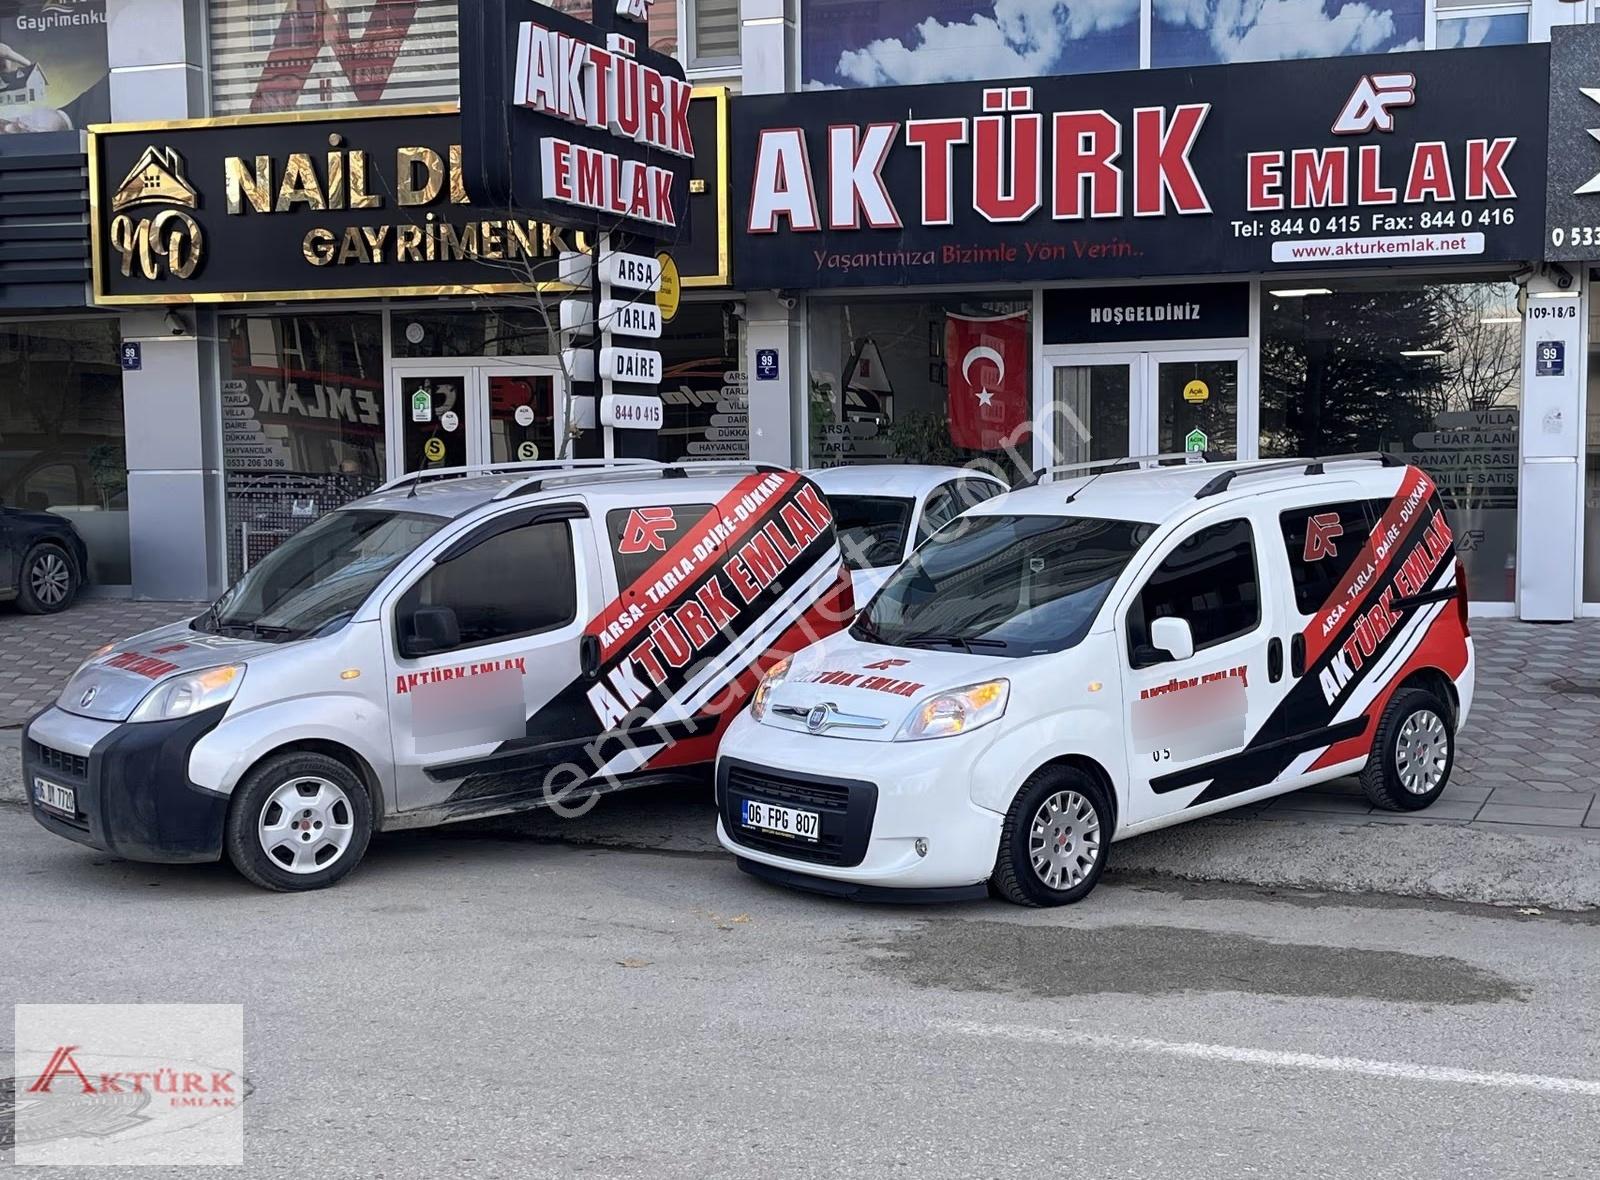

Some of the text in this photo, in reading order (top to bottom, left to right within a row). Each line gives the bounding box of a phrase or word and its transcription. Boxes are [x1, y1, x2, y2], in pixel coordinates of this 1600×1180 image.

[513, 21, 695, 159] AKTÜRK
[747, 86, 1213, 234] AKTÜRK
[224, 133, 383, 215] NAİL
[540, 137, 676, 227] EMLAK
[1247, 137, 1518, 212] EMLAK
[1231, 208, 1514, 237] Tel: 844 0 415 Fax: 844 0 416
[1292, 236, 1467, 259] www.akturkemlak.net
[1552, 228, 1564, 247] 0
[814, 248, 935, 273] Yaşantınıza
[942, 244, 1017, 265] Bizimle
[1024, 242, 1065, 263] Yön
[618, 259, 654, 285] ARSA
[616, 306, 656, 331] TARLA
[1091, 302, 1200, 325] HOŞGELDİNİZ
[1528, 306, 1576, 319] 109-18/B
[617, 352, 655, 377] DAİRE
[761, 355, 773, 366] 99
[1543, 348, 1557, 360] 99
[224, 395, 249, 403] TARLA
[615, 404, 660, 421] 844 0 415
[728, 415, 748, 423] DAİR
[1476, 413, 1515, 424] VİLLA
[226, 432, 256, 441] DÜKKAN
[718, 428, 749, 437] DÜKKA
[820, 425, 851, 434] ARSA
[1434, 433, 1515, 444] FUAR ALANI
[699, 443, 749, 451] HAYVANCILI
[820, 442, 856, 452] TARLA
[1411, 453, 1514, 465] SANAYİ ARSASI
[1478, 472, 1514, 486] SATIŞ
[1321, 477, 1428, 637] ARSA TARLA DAİRE DÜKKAN
[586, 483, 833, 732] AKTÜRK EMLAK
[1319, 509, 1454, 706] AKTÜRK EMLAK
[748, 803, 762, 824] 06
[768, 807, 789, 829] FPG
[796, 813, 818, 835] 807
